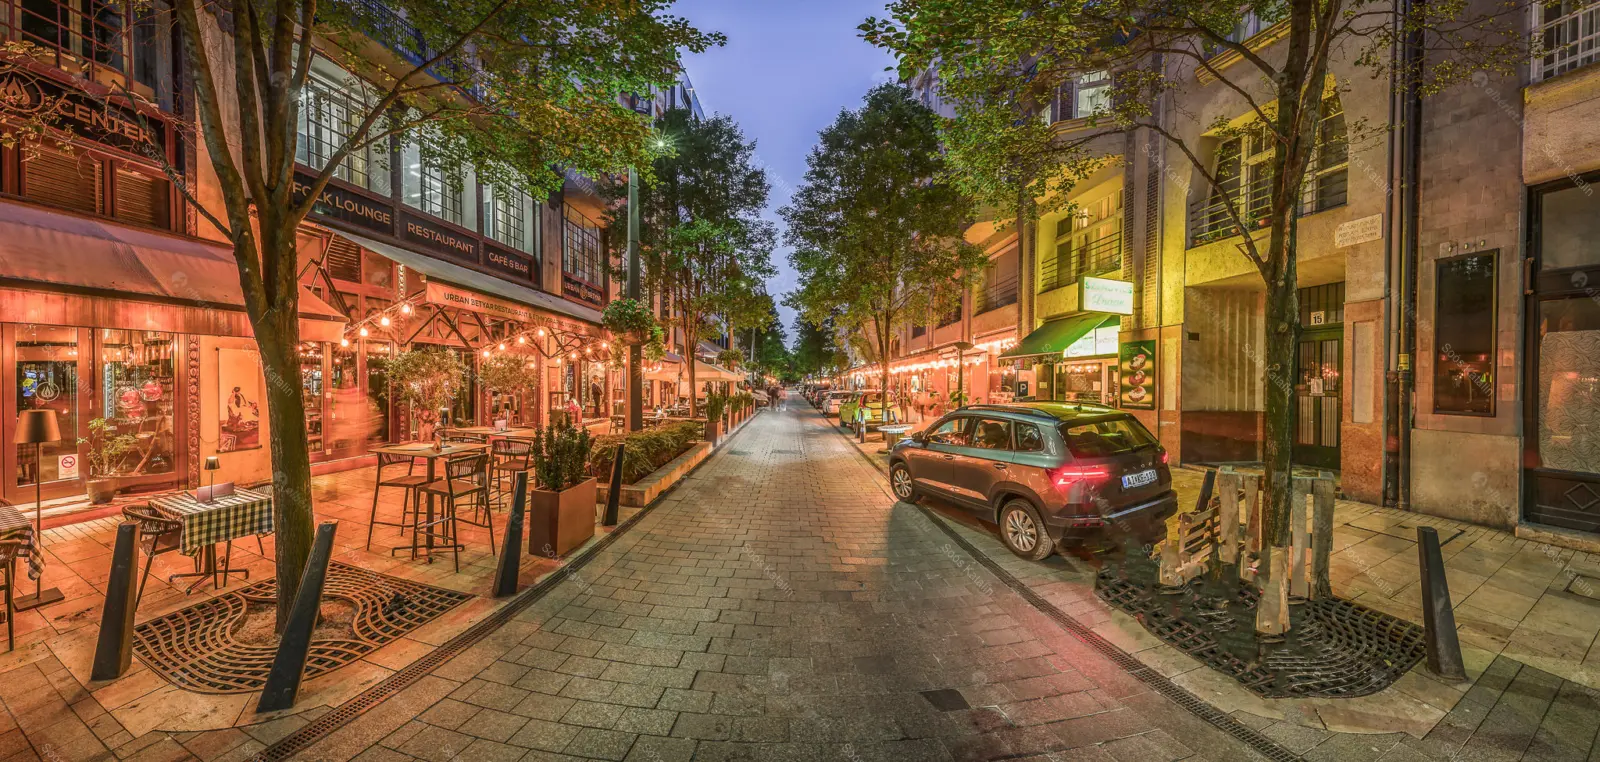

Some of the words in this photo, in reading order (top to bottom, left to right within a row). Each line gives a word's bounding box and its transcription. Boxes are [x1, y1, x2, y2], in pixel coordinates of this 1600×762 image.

[56, 98, 154, 145] CENTER
[335, 196, 391, 225] LOUNGE
[407, 222, 474, 254] RESTAURANT
[488, 252, 509, 266] CAFÉ
[514, 262, 529, 274] BAR
[443, 292, 470, 306] URBAN
[494, 304, 528, 319] RESTAURANT
[1313, 315, 1323, 324] 15
[1020, 384, 1027, 393] P
